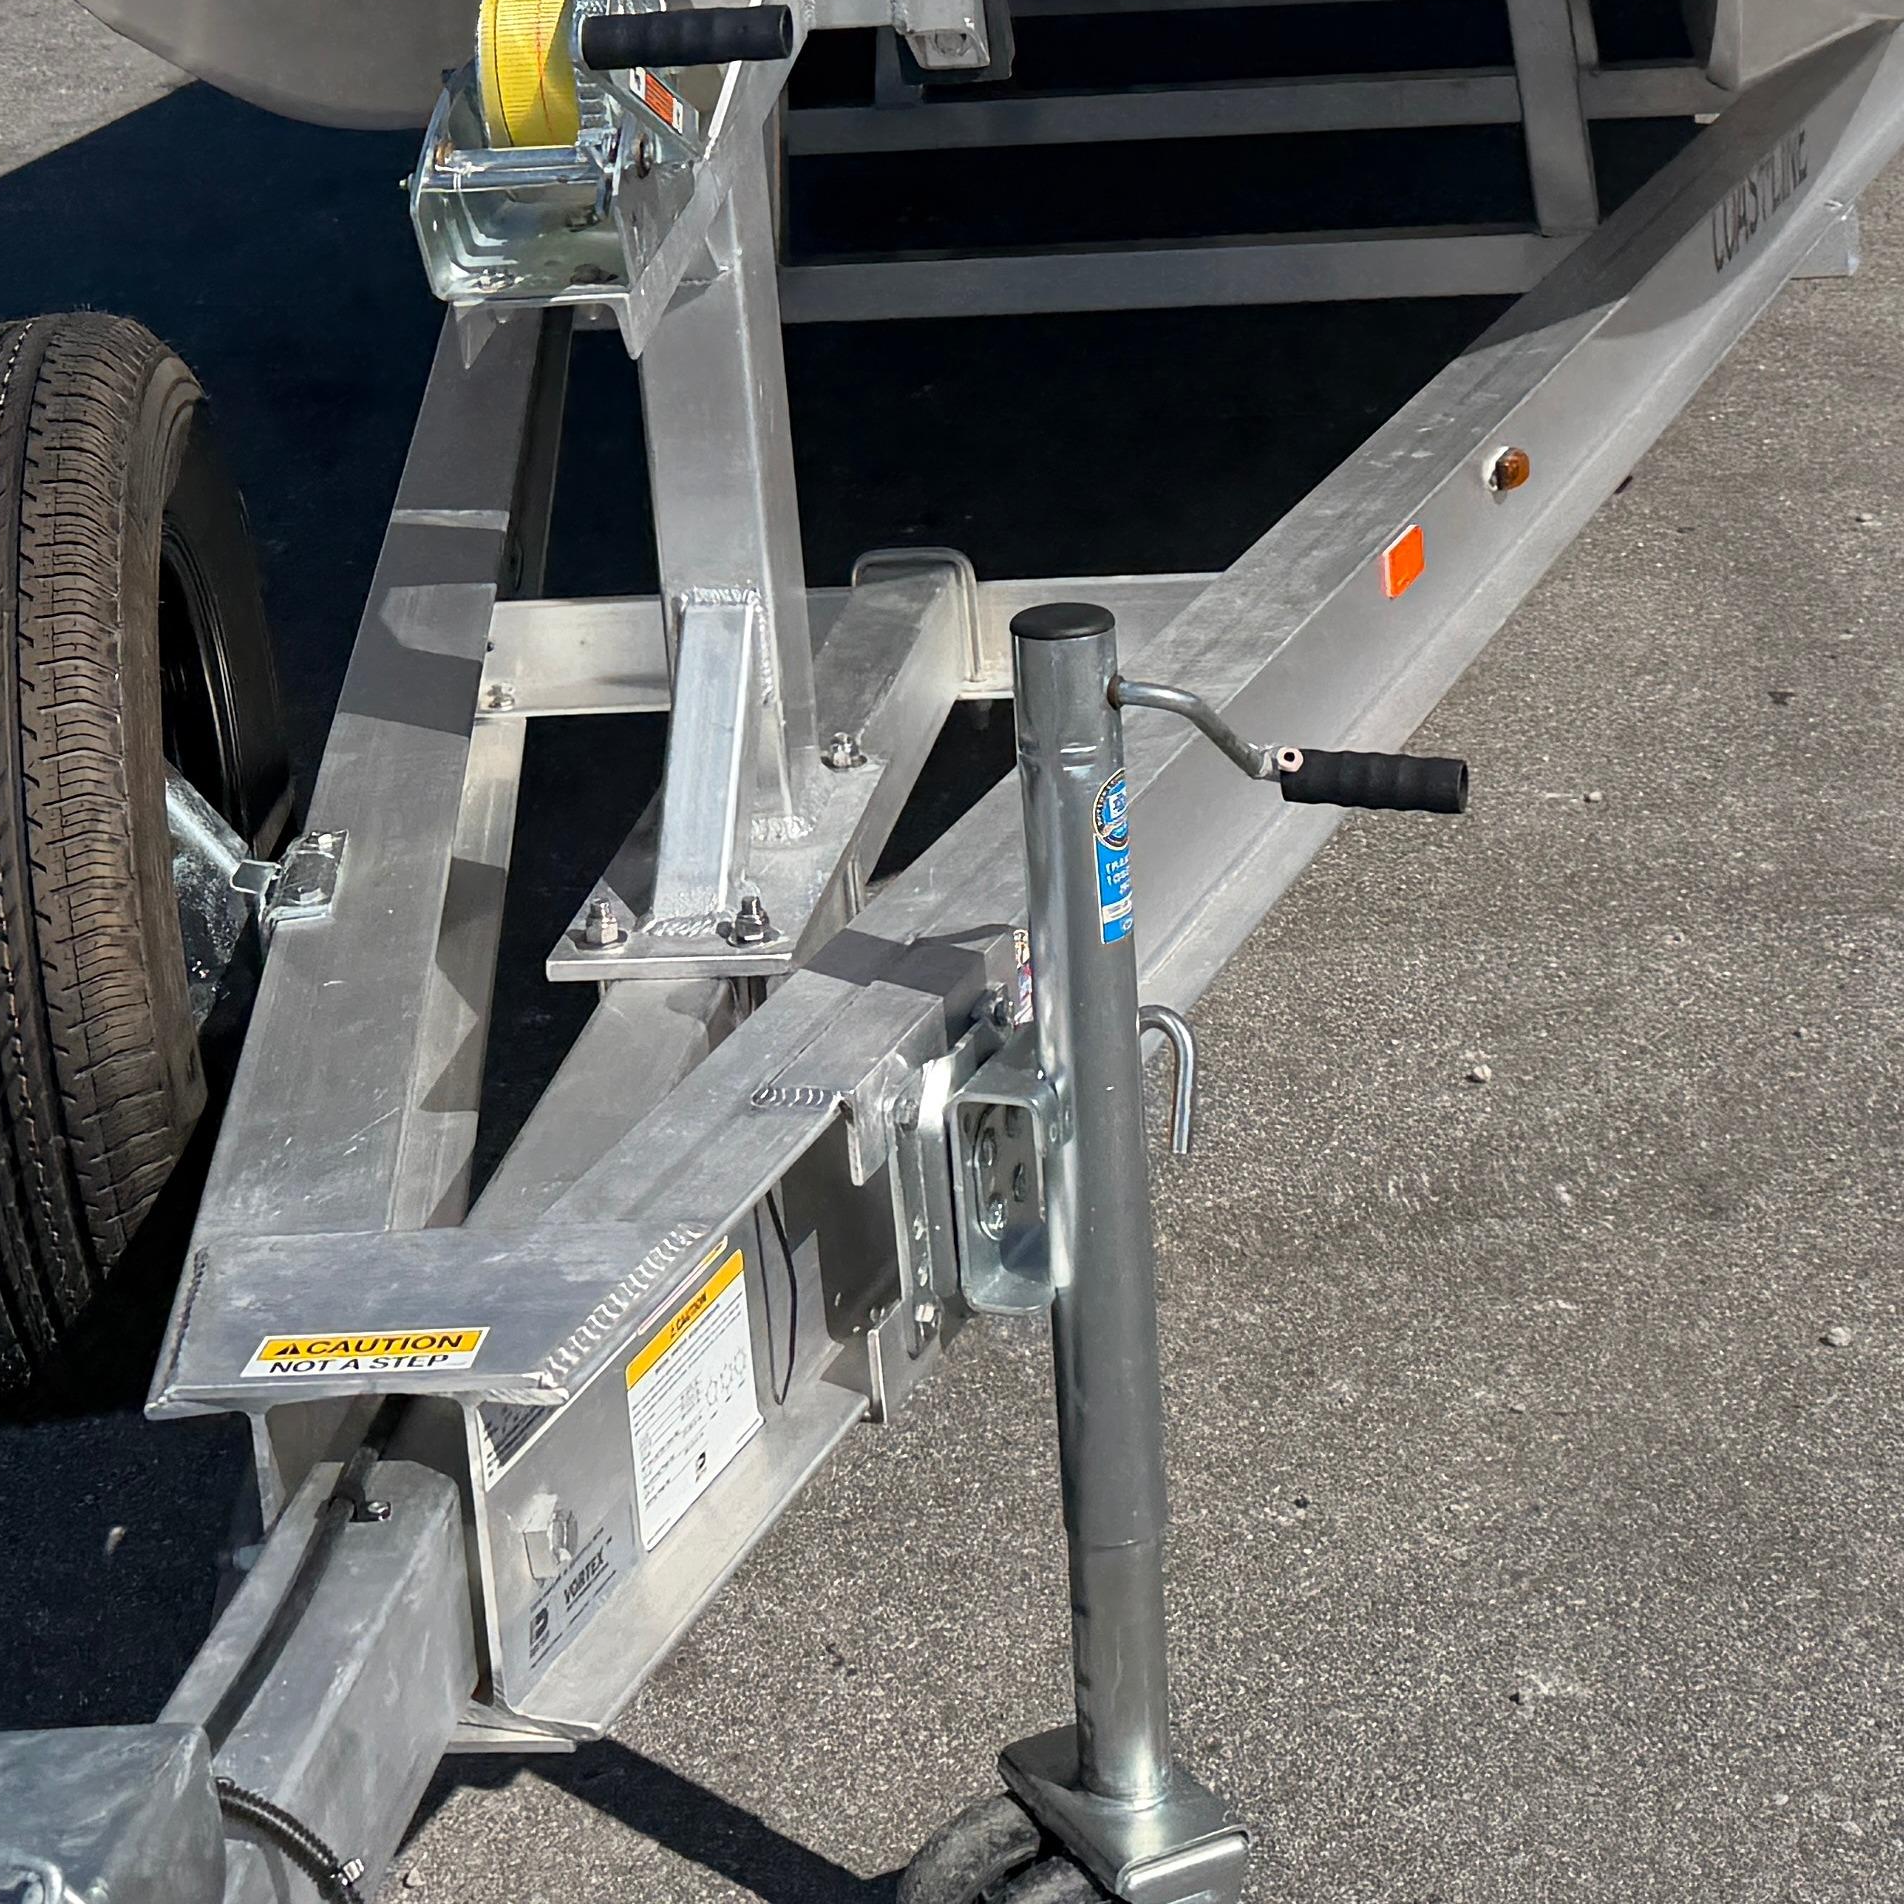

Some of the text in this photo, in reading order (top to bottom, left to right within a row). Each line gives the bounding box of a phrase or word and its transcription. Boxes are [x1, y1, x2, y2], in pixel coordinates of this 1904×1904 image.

[305, 1333, 464, 1356] CAUTION
[269, 1353, 450, 1374] NOT A STEP
[563, 1547, 605, 1605] VORTEX
